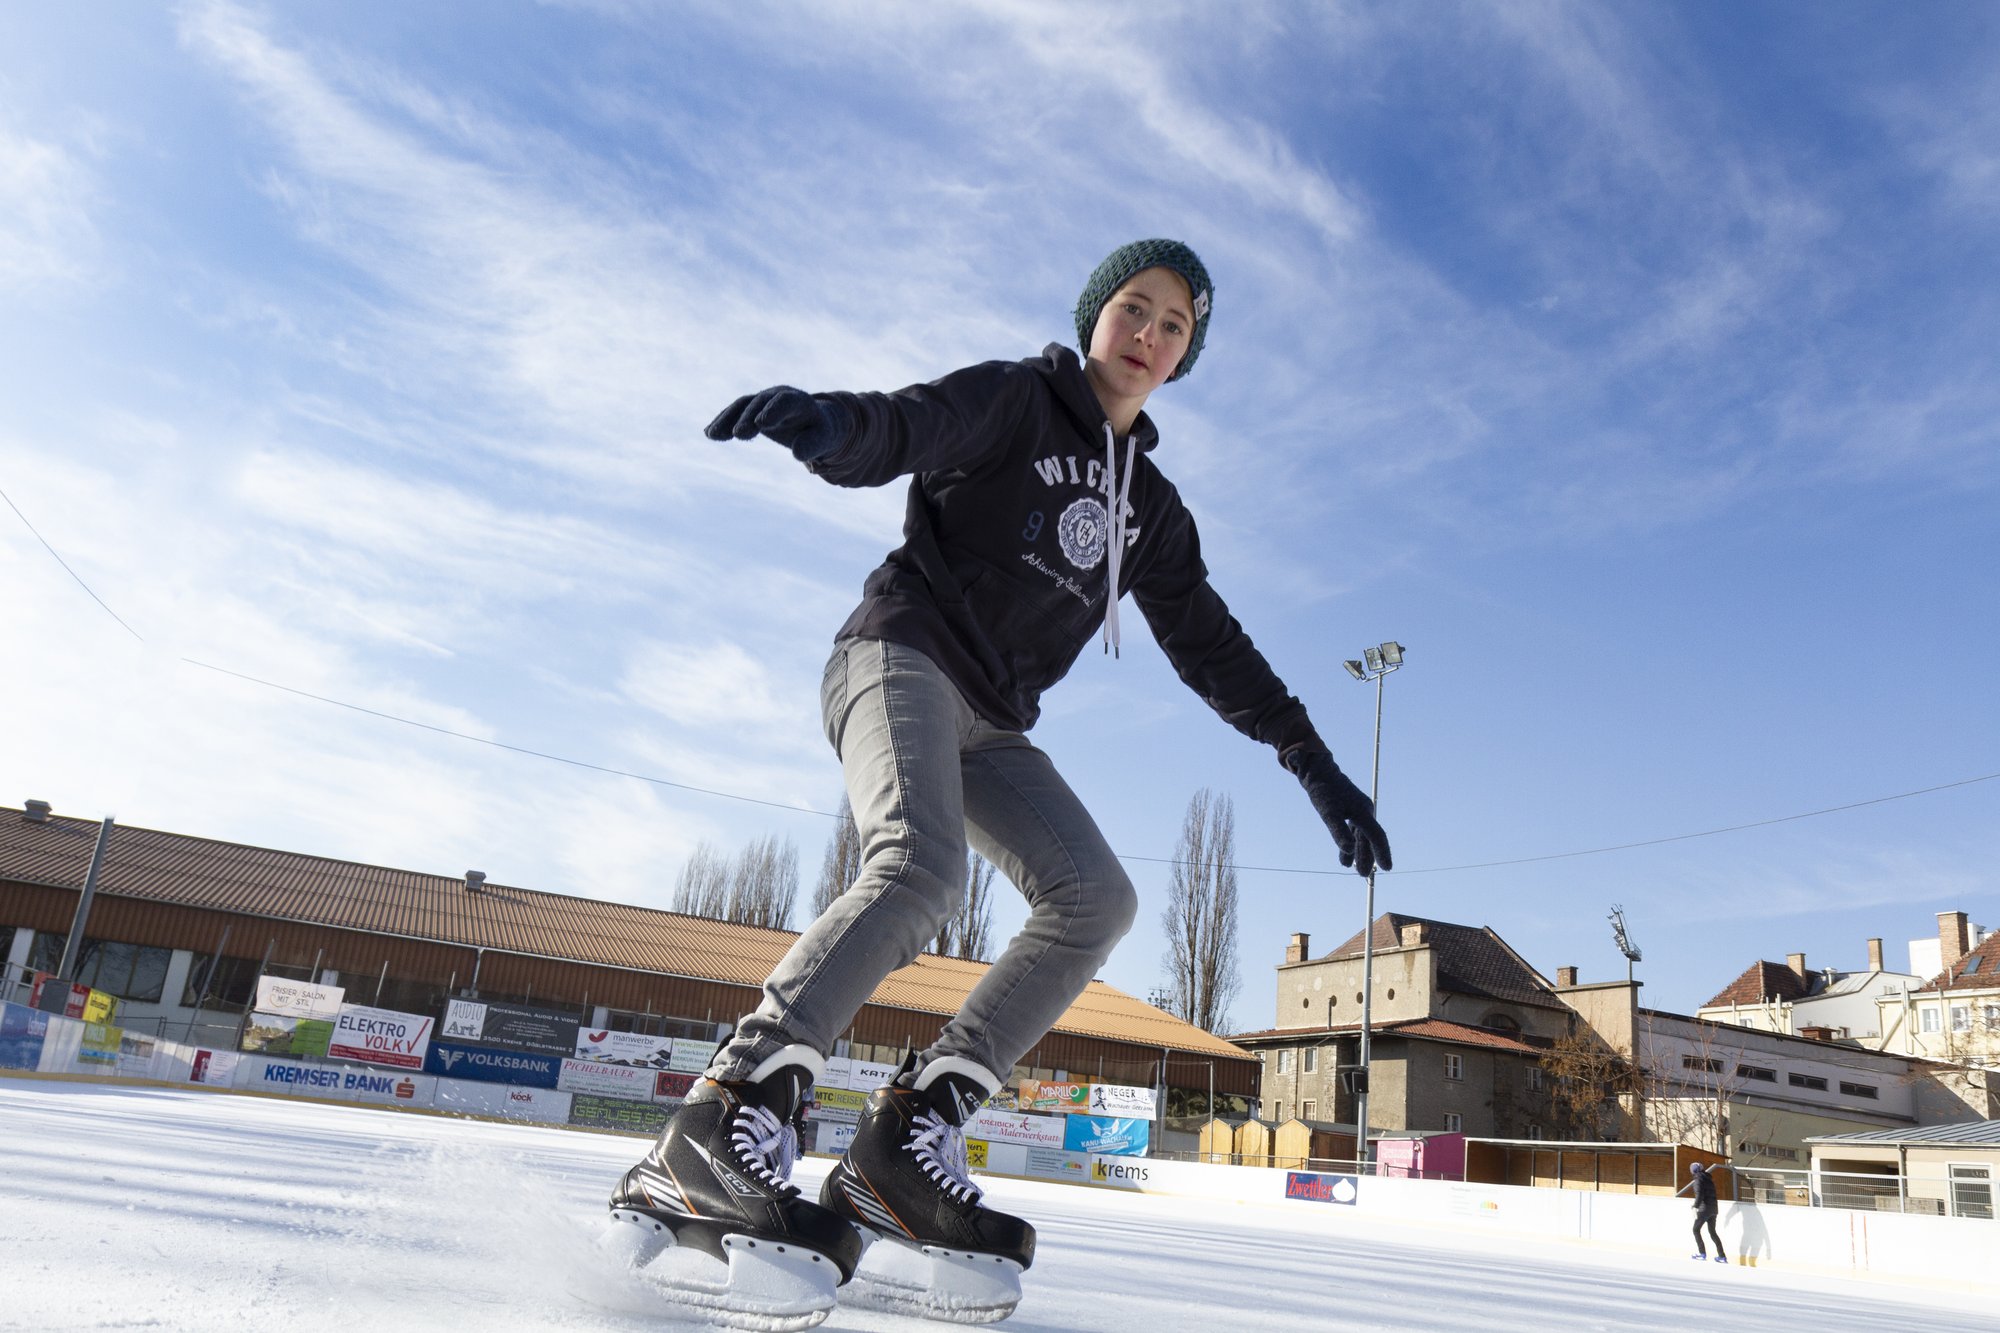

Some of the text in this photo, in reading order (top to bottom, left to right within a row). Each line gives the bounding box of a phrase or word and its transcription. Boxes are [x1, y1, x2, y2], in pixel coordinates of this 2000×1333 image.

[1022, 510, 1045, 541] 9
[272, 985, 326, 1000] FRISIER SALON
[277, 995, 310, 1007] MIT STIL
[452, 1002, 482, 1021] AUDIO
[339, 1015, 406, 1038] ELEKTRO
[445, 1021, 480, 1038] Art.
[365, 1034, 404, 1052] VOLK
[613, 1034, 655, 1046] manwerbe
[467, 1052, 550, 1073] VOLKSBANK
[564, 1060, 635, 1078] PICHELBAUER
[264, 1064, 395, 1094] KREMSER BANK
[511, 1091, 532, 1102] köck
[815, 1091, 834, 1102] MTC
[1040, 1085, 1080, 1099] MARILLO
[1108, 1087, 1136, 1098] NEGER
[978, 1119, 1015, 1129] KREIBICH
[998, 1127, 1059, 1142] Malerwerkstatt
[1097, 1158, 1149, 1181] krems
[724, 1172, 751, 1194] CCM
[1287, 1173, 1334, 1199] Zwettler
